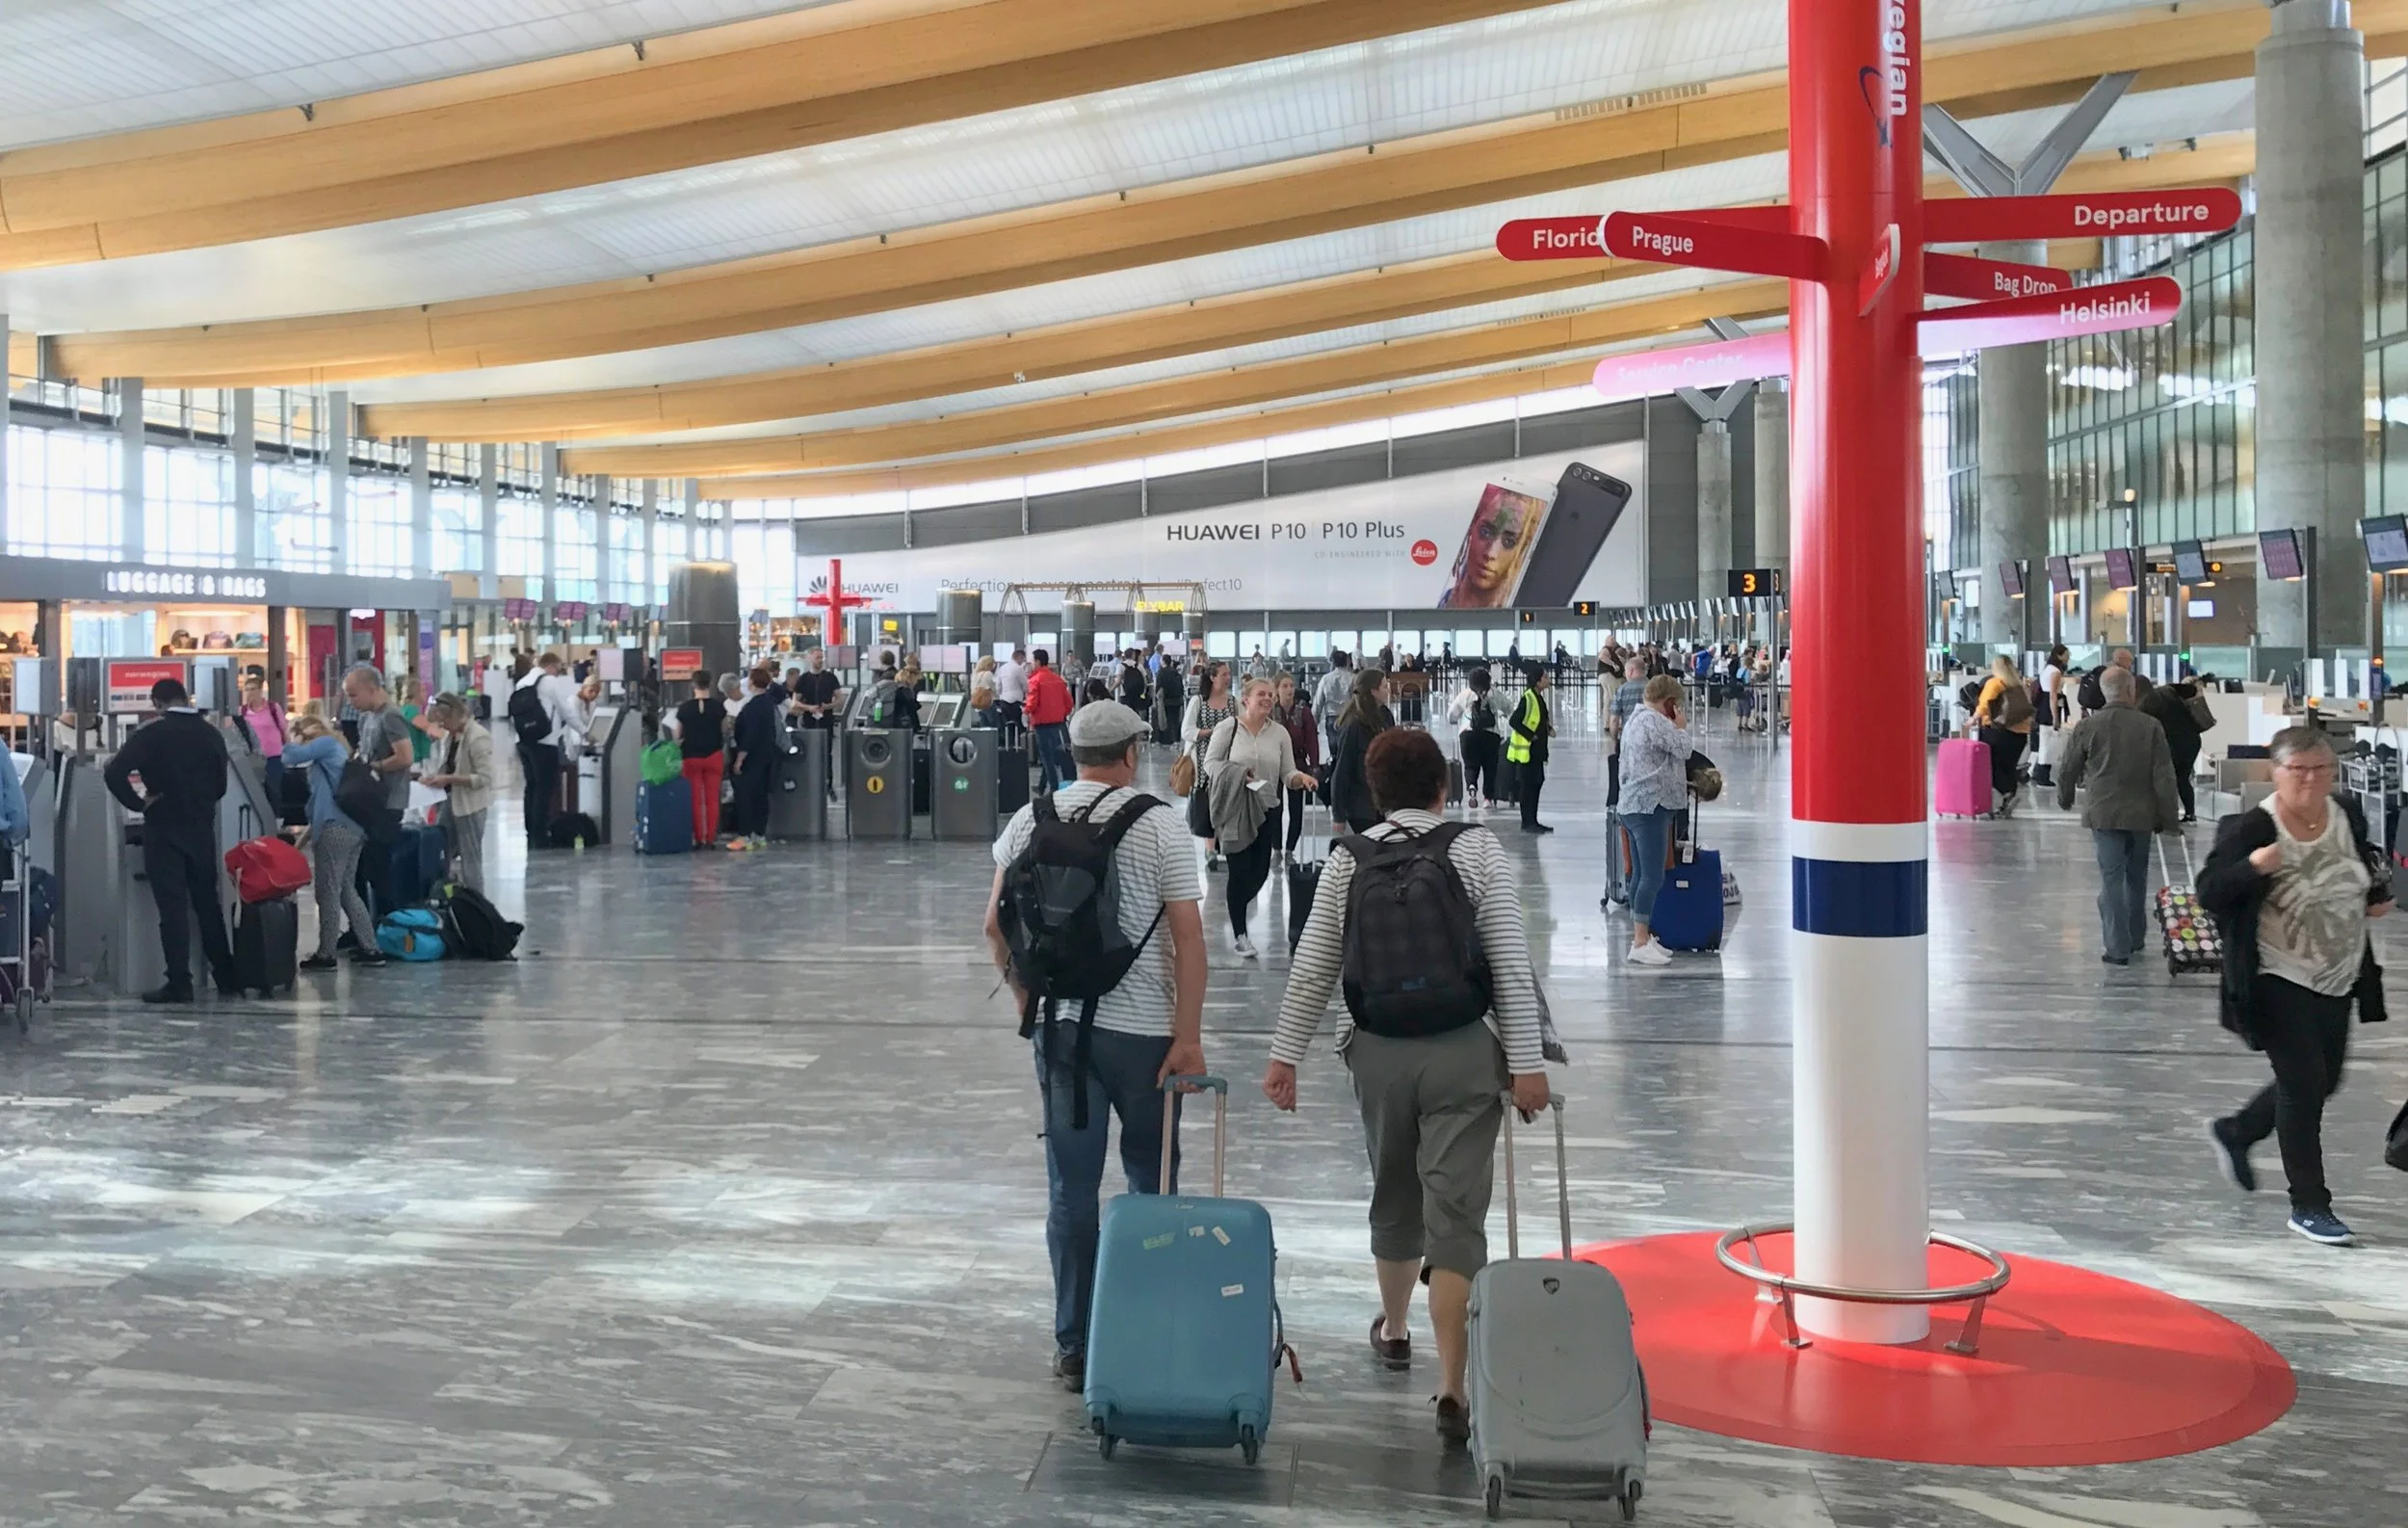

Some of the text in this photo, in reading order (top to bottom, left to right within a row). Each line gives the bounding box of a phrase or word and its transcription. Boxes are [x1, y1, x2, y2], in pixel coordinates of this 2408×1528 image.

[1883, 0, 1911, 117] egian
[2074, 201, 2210, 229] Departure
[1532, 227, 1600, 250] Florid
[1632, 224, 1694, 256] Prague
[1994, 271, 2020, 297] Bag
[2059, 291, 2151, 326] Helsinki
[1166, 520, 1405, 540] HUAWEI P10 P10 Plus
[107, 570, 195, 594] LUGGAGE
[222, 575, 267, 598] BAGS
[841, 582, 900, 594] HUAWEI
[941, 577, 1014, 593] Perfection
[1742, 572, 1757, 593] 3
[1524, 613, 1531, 622] 1
[1581, 603, 1589, 616] 2
